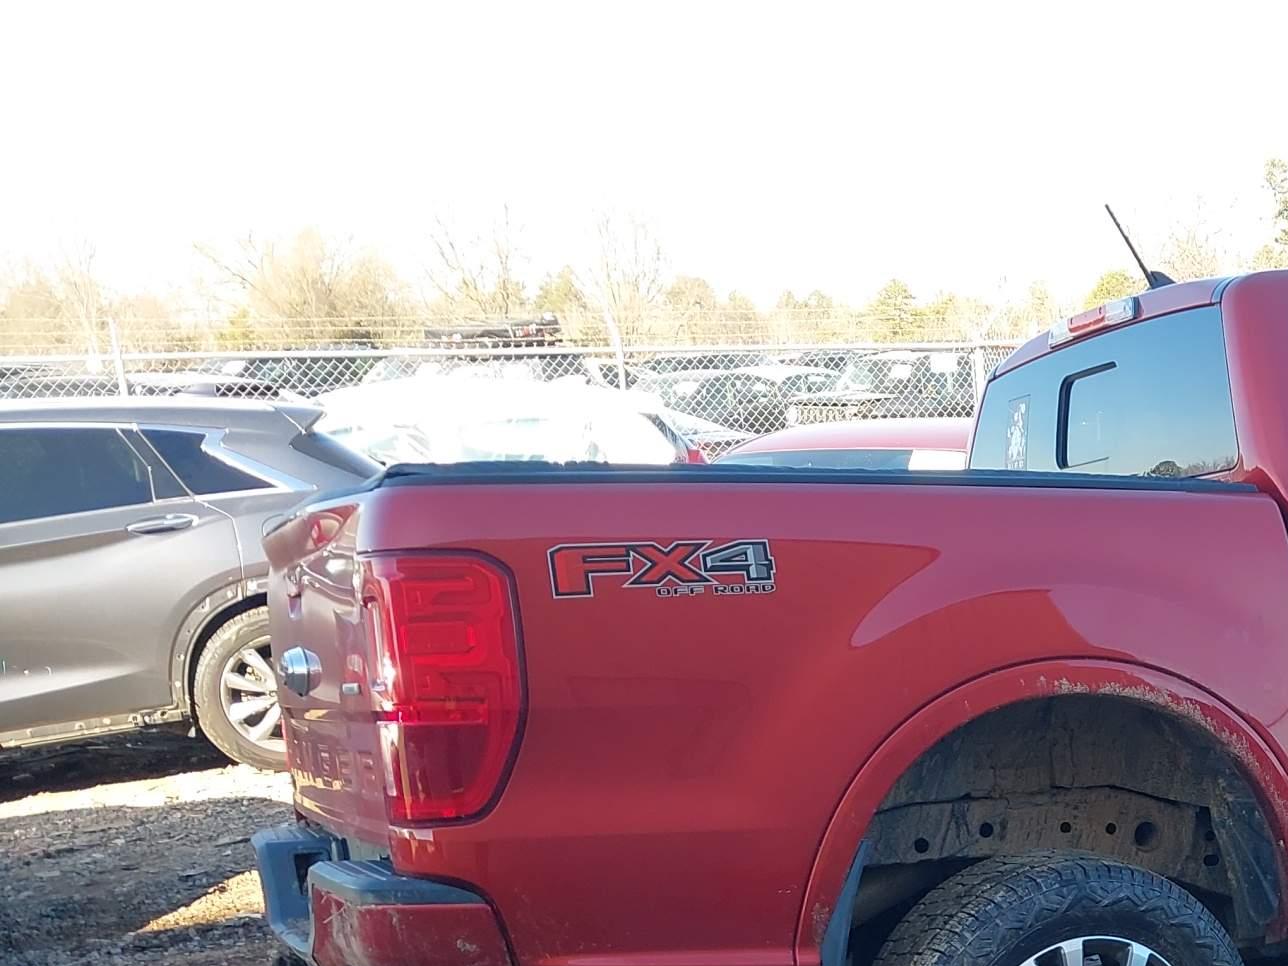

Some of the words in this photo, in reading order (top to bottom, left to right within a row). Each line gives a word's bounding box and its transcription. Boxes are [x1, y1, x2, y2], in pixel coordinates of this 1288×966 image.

[547, 539, 776, 598] FX4
[656, 584, 704, 598] OFF
[713, 583, 776, 595] ROAD
